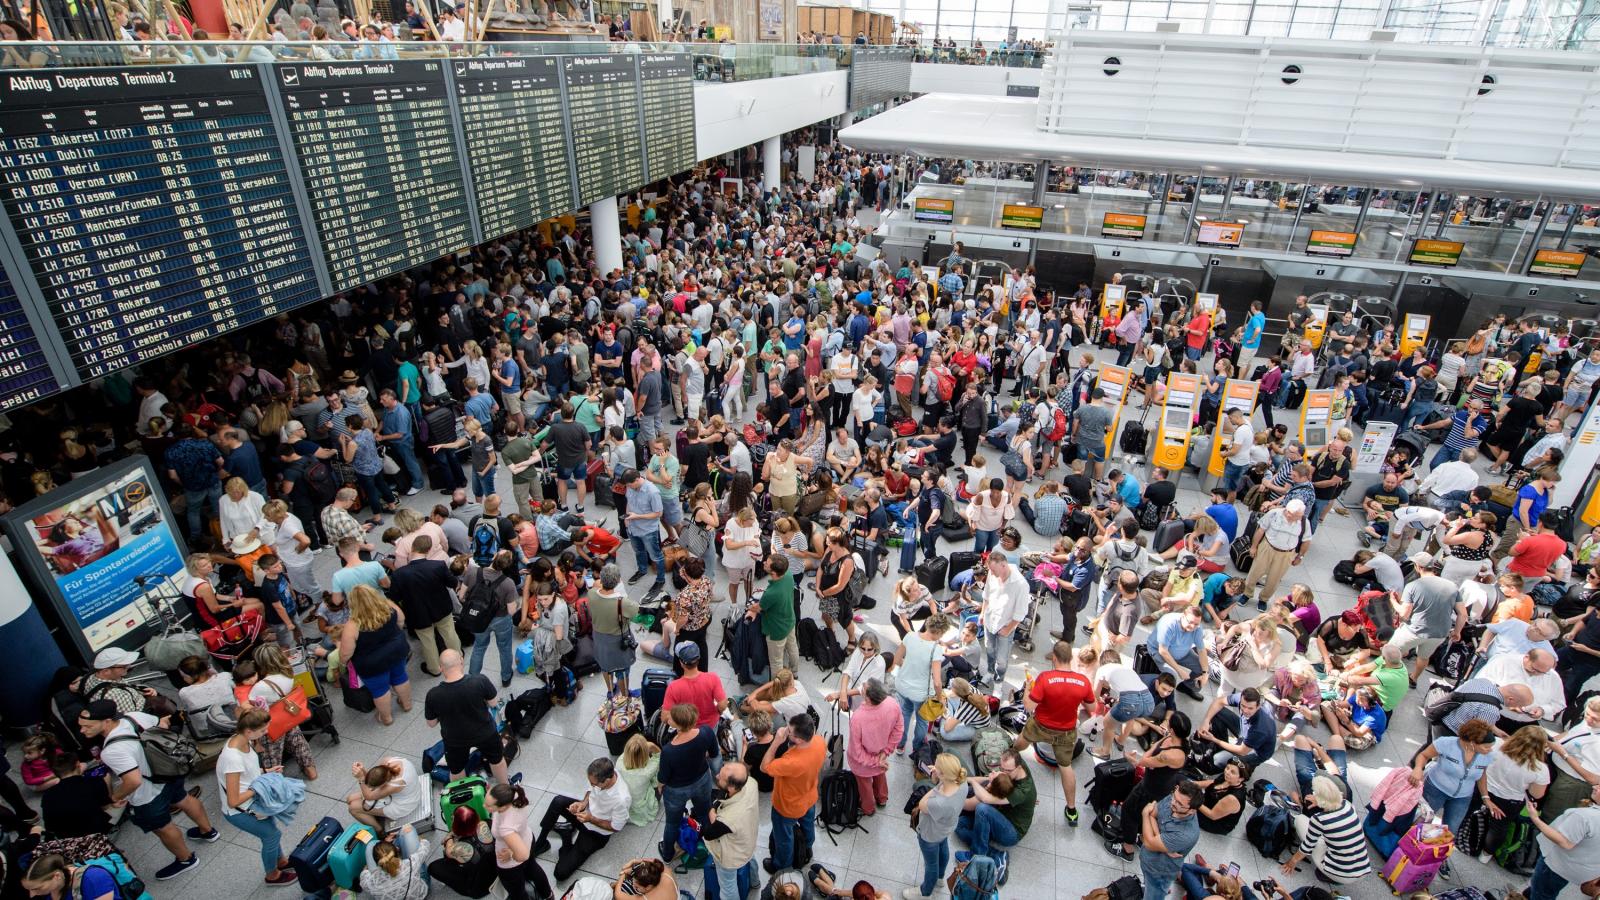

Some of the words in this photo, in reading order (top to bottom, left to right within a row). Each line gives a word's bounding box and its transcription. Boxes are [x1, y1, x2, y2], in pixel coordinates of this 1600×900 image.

[10, 76, 52, 92] Abflug
[56, 74, 119, 90] Departures
[122, 72, 166, 85] Terminal
[168, 71, 176, 83] 2
[230, 69, 251, 80] 10:14
[304, 66, 326, 78] Abflug
[328, 66, 362, 77] Departures
[364, 64, 388, 74] Terminal
[389, 65, 395, 74] 2
[13, 138, 41, 149] 1652
[50, 132, 100, 145] Bukarest
[147, 125, 174, 135] 08:25
[327, 119, 357, 128] Barcelona
[330, 131, 350, 139] Berlin
[333, 141, 356, 150] Catania
[0, 156, 14, 168] LH
[18, 153, 47, 165] 2514
[57, 148, 95, 160] Dublin
[152, 139, 179, 149] 08:25
[227, 129, 264, 140] verspätet
[5, 172, 21, 183] LH
[26, 168, 54, 180] 1800
[63, 163, 100, 175] Madrid
[157, 152, 183, 163] 08:25
[12, 188, 28, 199] EN
[31, 183, 60, 196] 8208
[69, 177, 105, 190] Verona
[162, 165, 187, 176] 08:25
[234, 153, 271, 165] verspätet
[18, 203, 34, 214] LH
[38, 198, 66, 211] 2518
[74, 190, 116, 204] Glasgow
[166, 178, 192, 189] 08:30
[341, 172, 363, 182] Palermo
[25, 218, 41, 229] LH
[44, 213, 71, 225] 2654
[80, 197, 162, 219] Madeira/Funchal
[171, 191, 196, 202] 08:30
[242, 177, 278, 189] verspätet
[31, 233, 47, 243] LH
[50, 227, 77, 240] 2500
[86, 215, 142, 233] Manchester
[175, 204, 200, 215] 08:30
[38, 247, 53, 258] LH
[58, 241, 83, 253] 1824
[91, 232, 126, 246] Bilbao
[180, 216, 204, 228] 08:35
[249, 200, 284, 213] verspätet
[44, 261, 59, 272] LH
[62, 255, 88, 268] 2462
[97, 243, 141, 260] Helsinki
[184, 228, 208, 240] 08:40
[253, 211, 287, 224] verspätet
[50, 275, 65, 286] LH
[68, 268, 94, 281] 2472
[102, 258, 136, 273] London
[188, 240, 212, 252] 08:40
[256, 222, 290, 236] verspätet
[56, 289, 71, 299] LH
[74, 281, 99, 295] 2452
[108, 274, 131, 286] Oslo
[192, 252, 216, 264] 08:40
[259, 233, 293, 247] verspätet
[62, 302, 76, 313] LH
[80, 295, 105, 308] 2302
[113, 280, 160, 299] Amsterdam
[196, 264, 220, 276] 08:45
[263, 243, 296, 258] verspätet
[68, 315, 82, 326] LH
[86, 308, 110, 321] 1784
[118, 296, 150, 312] Ankara
[200, 275, 224, 288] 08:50
[227, 268, 248, 280] 10:15
[266, 255, 297, 269] Check-in
[74, 328, 87, 339] LH
[91, 320, 115, 334] 2428
[123, 305, 164, 324] Göteborg
[204, 287, 228, 299] 08:50
[79, 341, 93, 352] LH
[97, 333, 120, 346] 1962
[128, 310, 192, 336] Lamezia-Terme
[208, 298, 231, 311] 08:55
[273, 275, 305, 290] verspätet
[85, 354, 98, 364] LH
[101, 345, 125, 359] 2550
[133, 331, 169, 348] Lemberg
[212, 309, 235, 322] 08:55
[90, 366, 103, 377] LH
[107, 357, 130, 371] 2414
[138, 339, 182, 360] Stockholm
[216, 320, 238, 333] 08:55
[0, 361, 28, 377] ätet
[64, 578, 83, 592] Für
[85, 535, 160, 582] Spontanreisende
